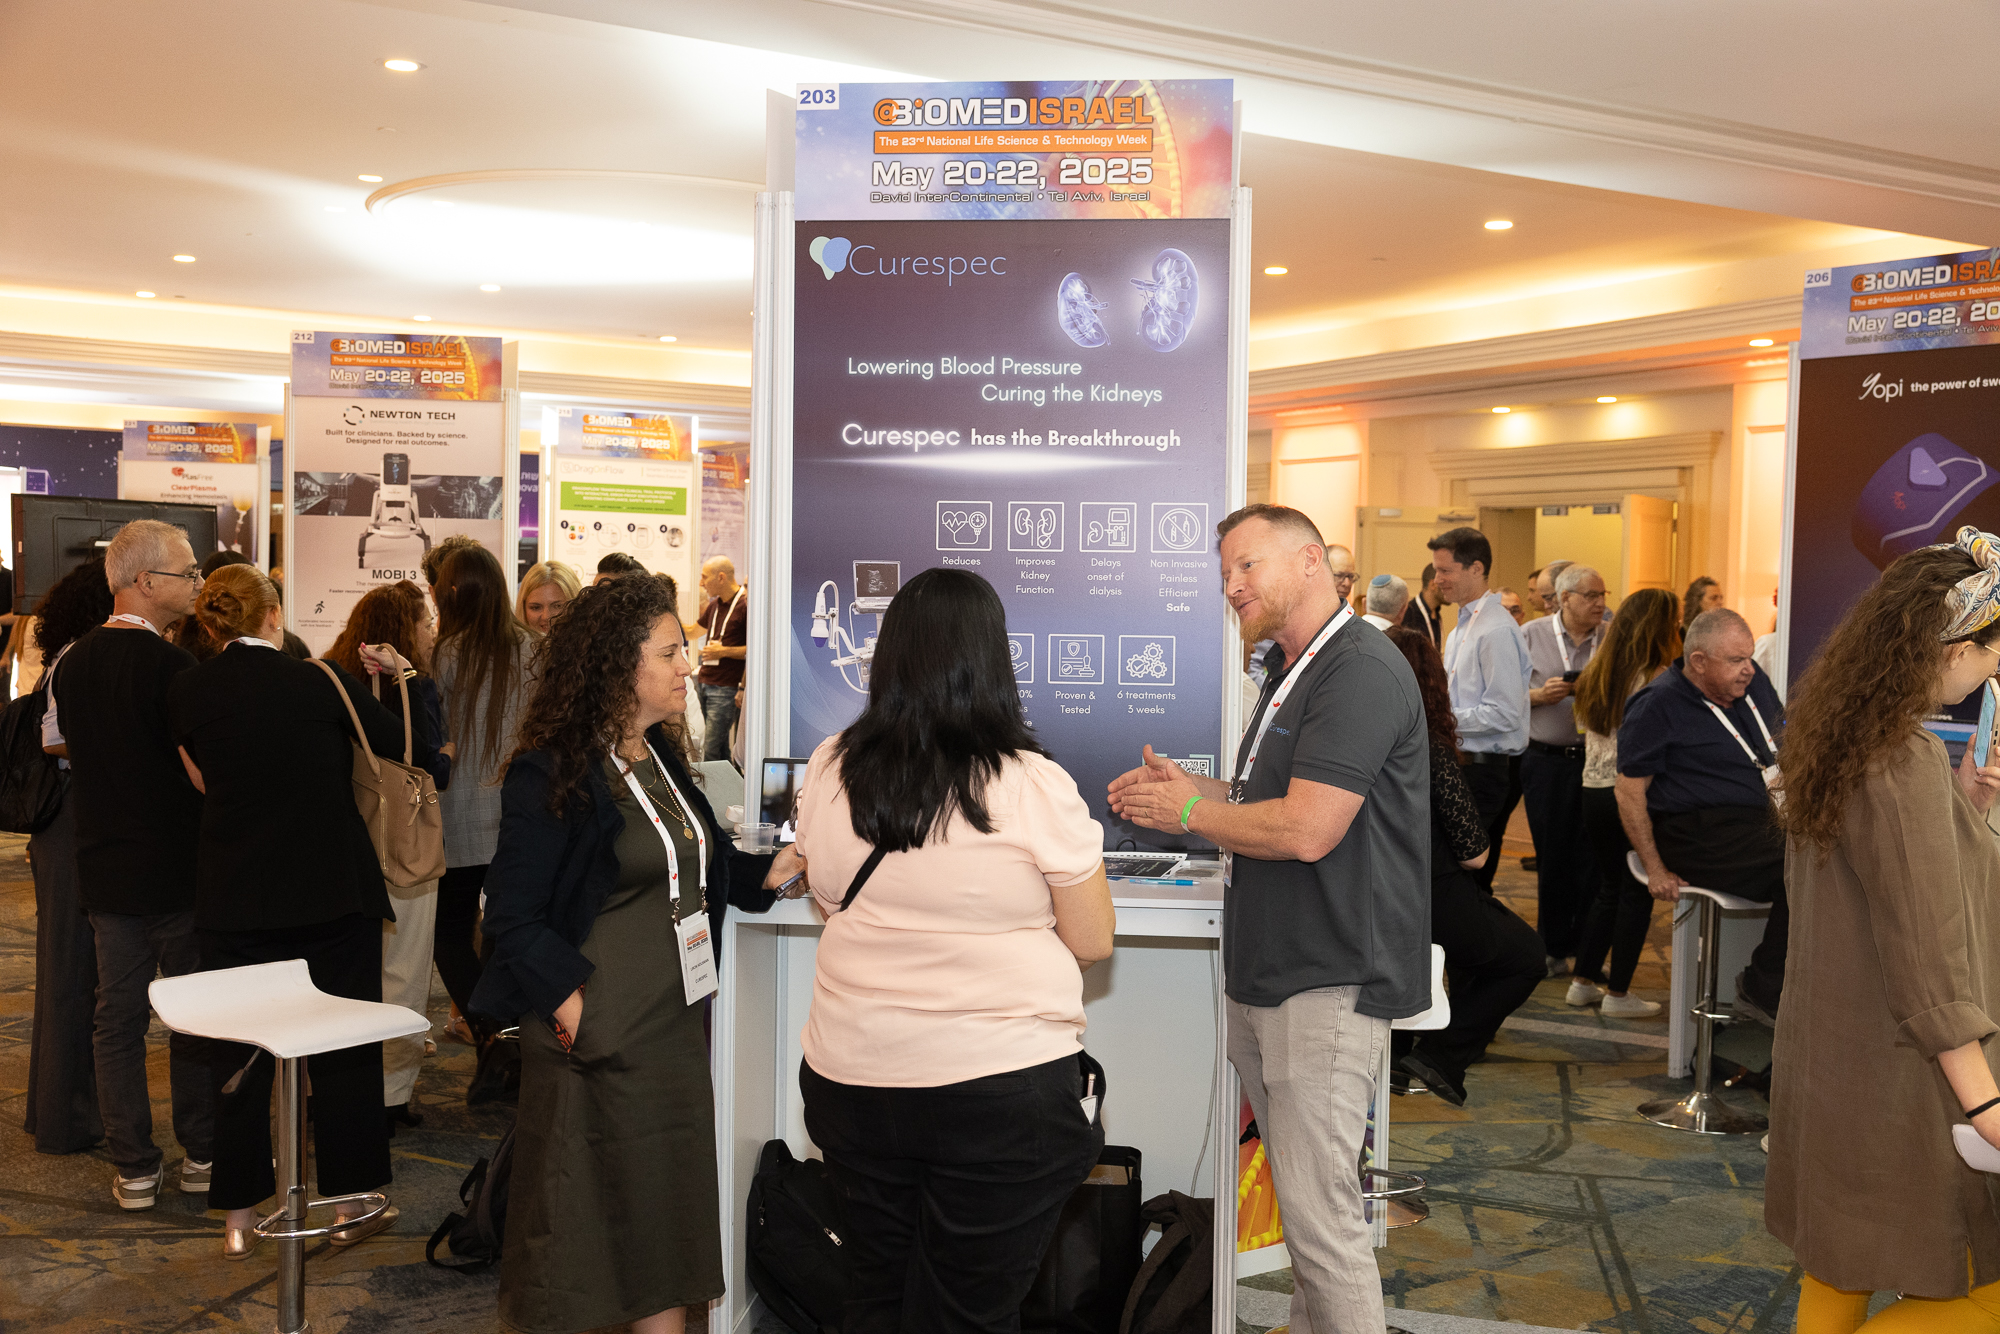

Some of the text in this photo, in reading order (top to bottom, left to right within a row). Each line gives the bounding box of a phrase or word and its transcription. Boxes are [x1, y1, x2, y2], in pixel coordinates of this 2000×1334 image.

[799, 89, 837, 105] 203
[879, 134, 1148, 148] The 23rd National Life Science & Technology Week
[872, 157, 1154, 190] May 20-22, 2025
[870, 190, 1151, 204] David InterContinental Tel Aviv, Israel
[849, 244, 1007, 287] Curespec
[1806, 272, 1830, 284] 206
[1851, 260, 2000, 293] @BiOMEDISRA
[1853, 299, 1867, 307] The
[1883, 294, 1914, 304] National
[1914, 292, 1928, 301] Life
[1929, 290, 1958, 300] Science
[1968, 285, 2000, 296] Technolo
[1847, 300, 2000, 334] May 20-22, 20
[293, 332, 313, 341] 212
[847, 356, 1083, 380] Lowering Blood Pressure
[329, 368, 466, 385] May 20-22, 2025
[1858, 372, 1904, 403] Yopi
[1910, 380, 1930, 392] the
[1930, 378, 1967, 394] power
[1968, 376, 1981, 389] of
[981, 383, 1163, 408] Curing the Kidneys
[369, 410, 456, 421] NEWTON TECH
[325, 428, 468, 440] Built for clinicians. Backed by science.
[841, 423, 1181, 452] Curespec has the Breakthrough
[345, 437, 450, 447] Designed for real outcomes.
[582, 435, 602, 446] May
[641, 438, 671, 450] 2025
[146, 443, 168, 452] May
[204, 445, 234, 454] 2025
[942, 556, 981, 566] Reduces
[1015, 556, 1056, 568] Improves
[1091, 557, 1122, 569] Delays
[1150, 558, 1208, 570] Non Invasive
[371, 569, 418, 580] MOBI 3
[1020, 570, 1051, 582] Kidney
[1087, 571, 1125, 582] onset of
[1160, 573, 1198, 584] Painless
[1015, 584, 1055, 595] Function
[1089, 585, 1122, 598] dialysis
[1158, 587, 1199, 598] Efficient
[1166, 602, 1191, 613] Safe
[1055, 690, 1096, 700] Proven &
[1116, 690, 1176, 700] 6 treatments
[1060, 704, 1091, 714] Tested
[1136, 704, 1166, 715] weeks
